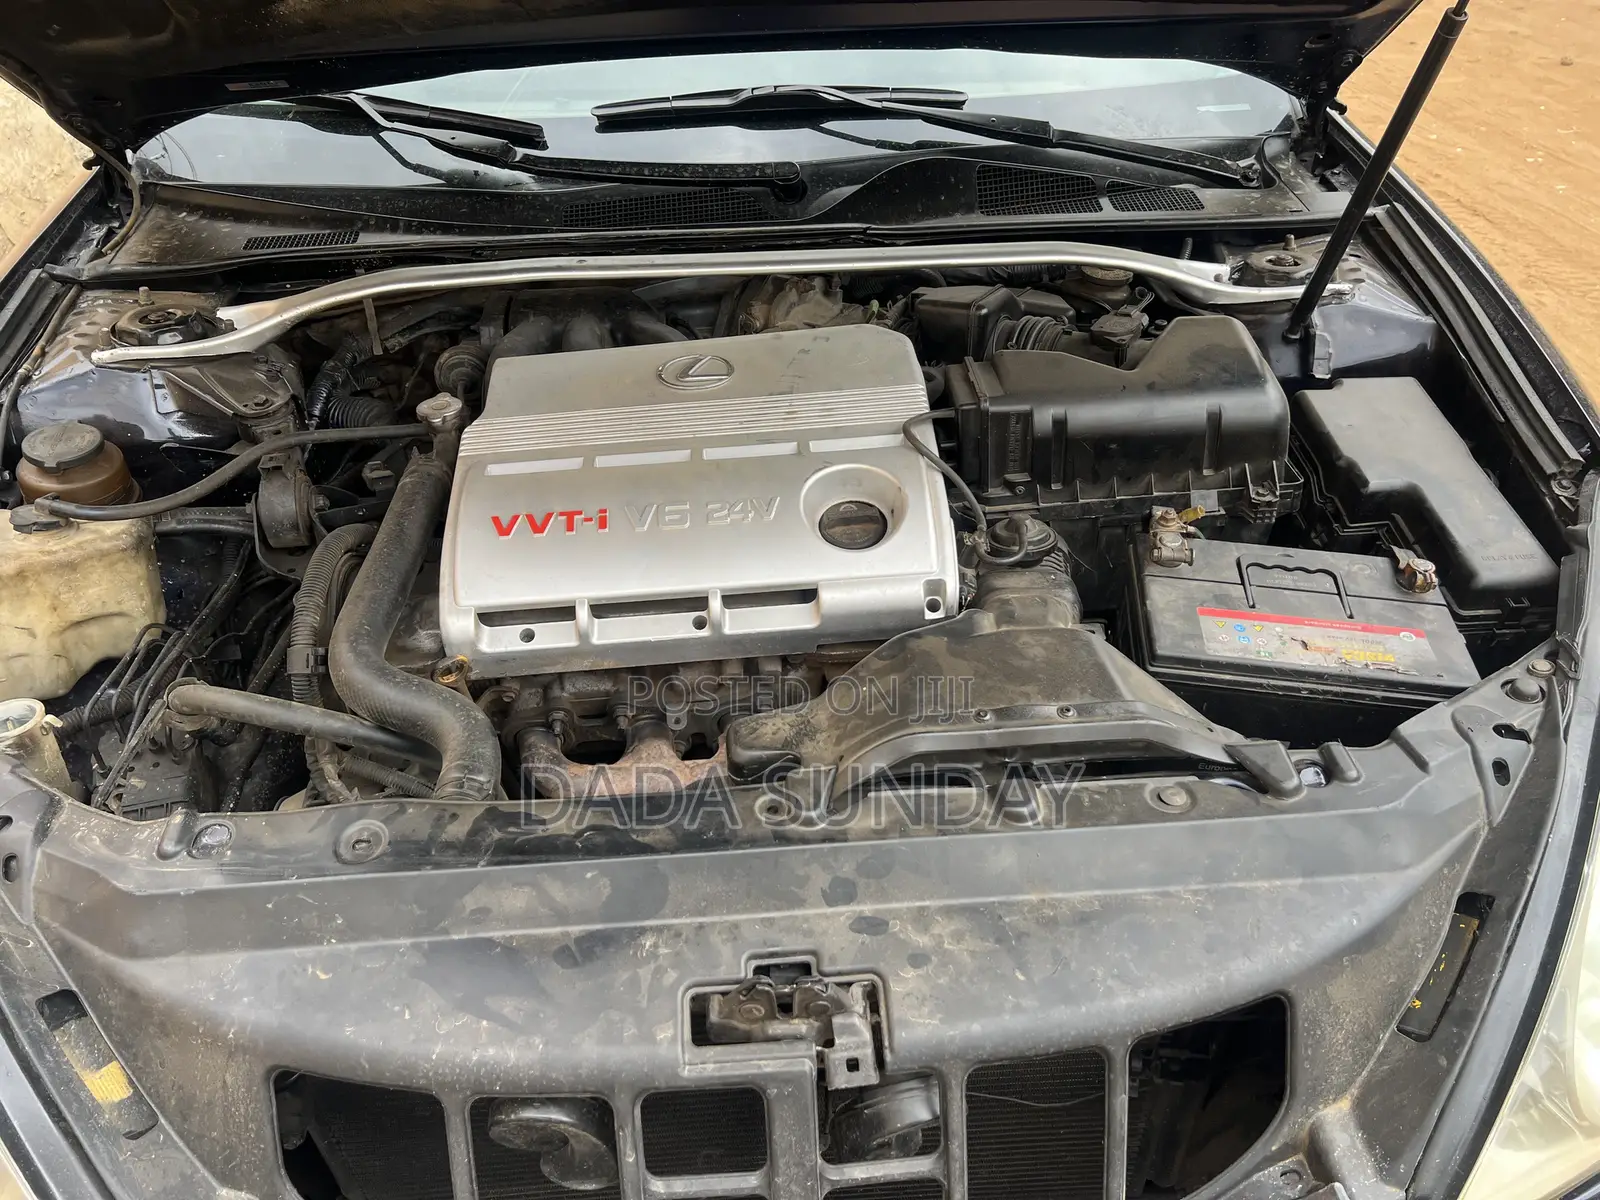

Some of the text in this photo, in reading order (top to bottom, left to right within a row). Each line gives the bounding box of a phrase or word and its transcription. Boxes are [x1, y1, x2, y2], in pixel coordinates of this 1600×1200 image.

[491, 496, 780, 540] VVT-i V6 24V
